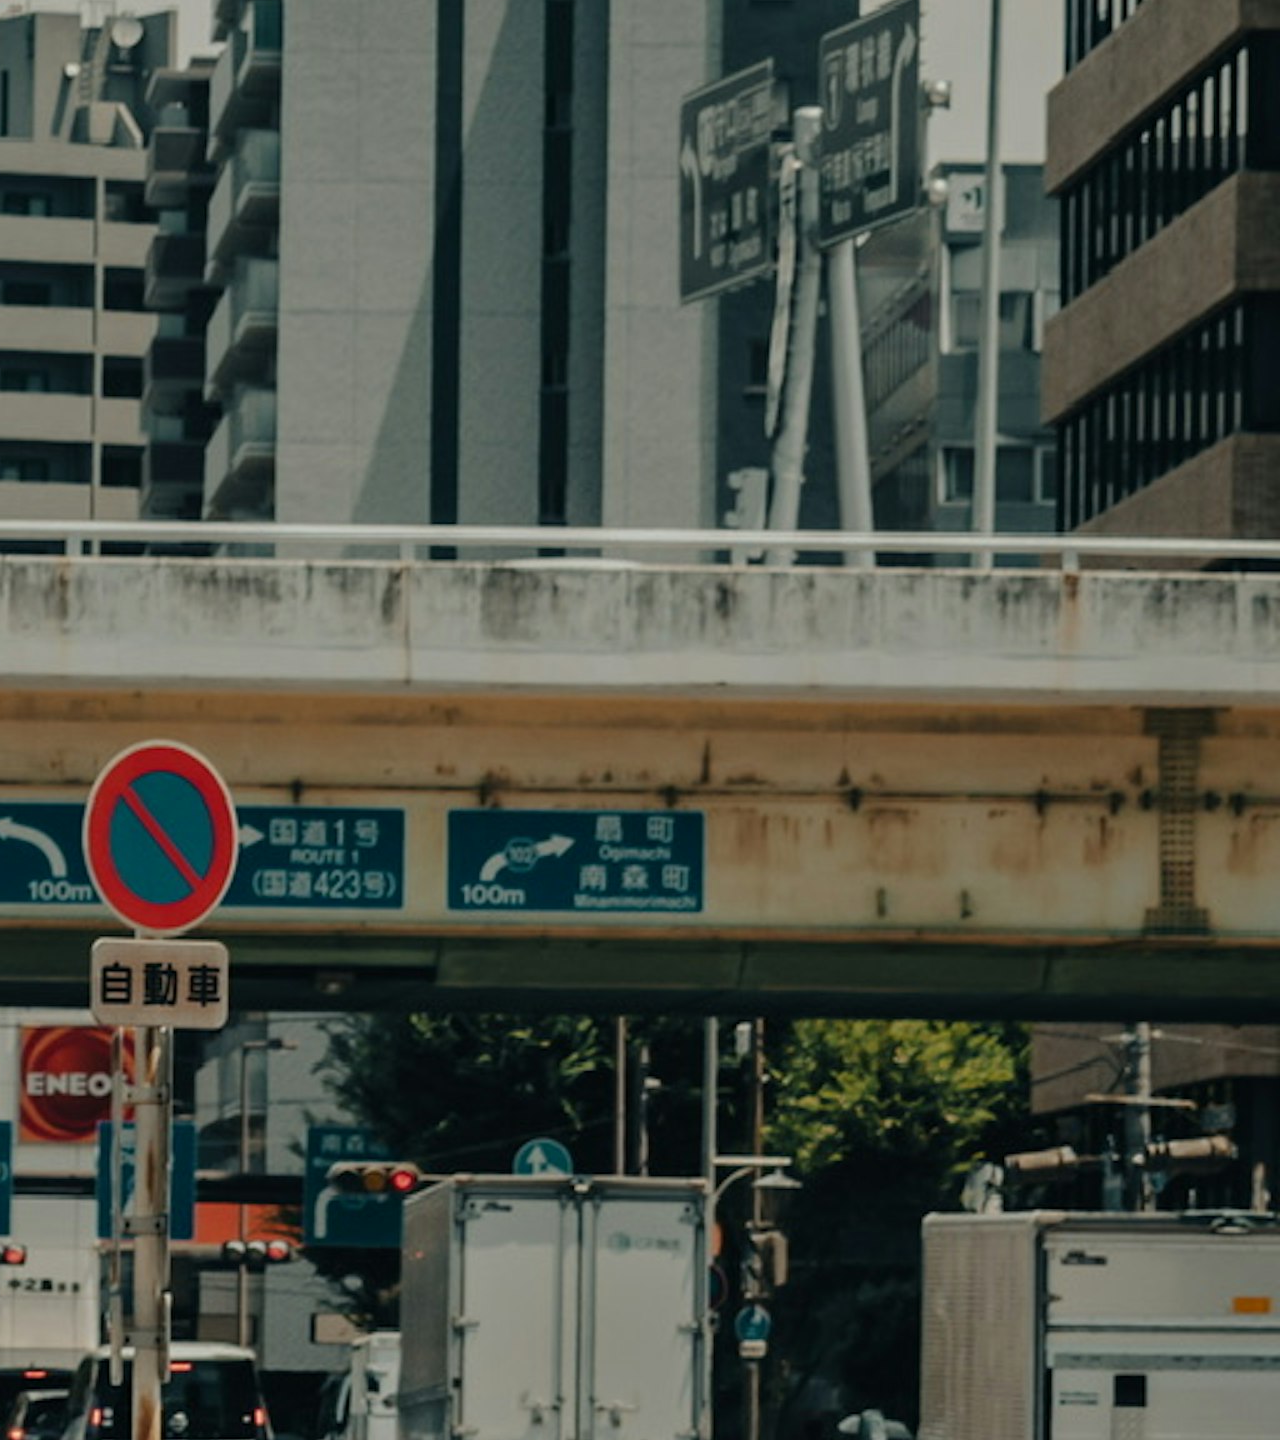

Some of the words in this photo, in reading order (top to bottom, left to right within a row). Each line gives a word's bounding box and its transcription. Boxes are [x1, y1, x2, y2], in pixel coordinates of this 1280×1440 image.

[269, 818, 379, 847] 国道1号
[291, 848, 346, 865] ROUTE
[351, 849, 360, 864] 1
[599, 844, 671, 862] Ogimachi
[28, 880, 93, 901] 100m
[252, 869, 397, 899] (国道423号)
[579, 863, 690, 893] 南森町
[460, 883, 526, 905] 100m
[101, 961, 220, 1008] 自動車
